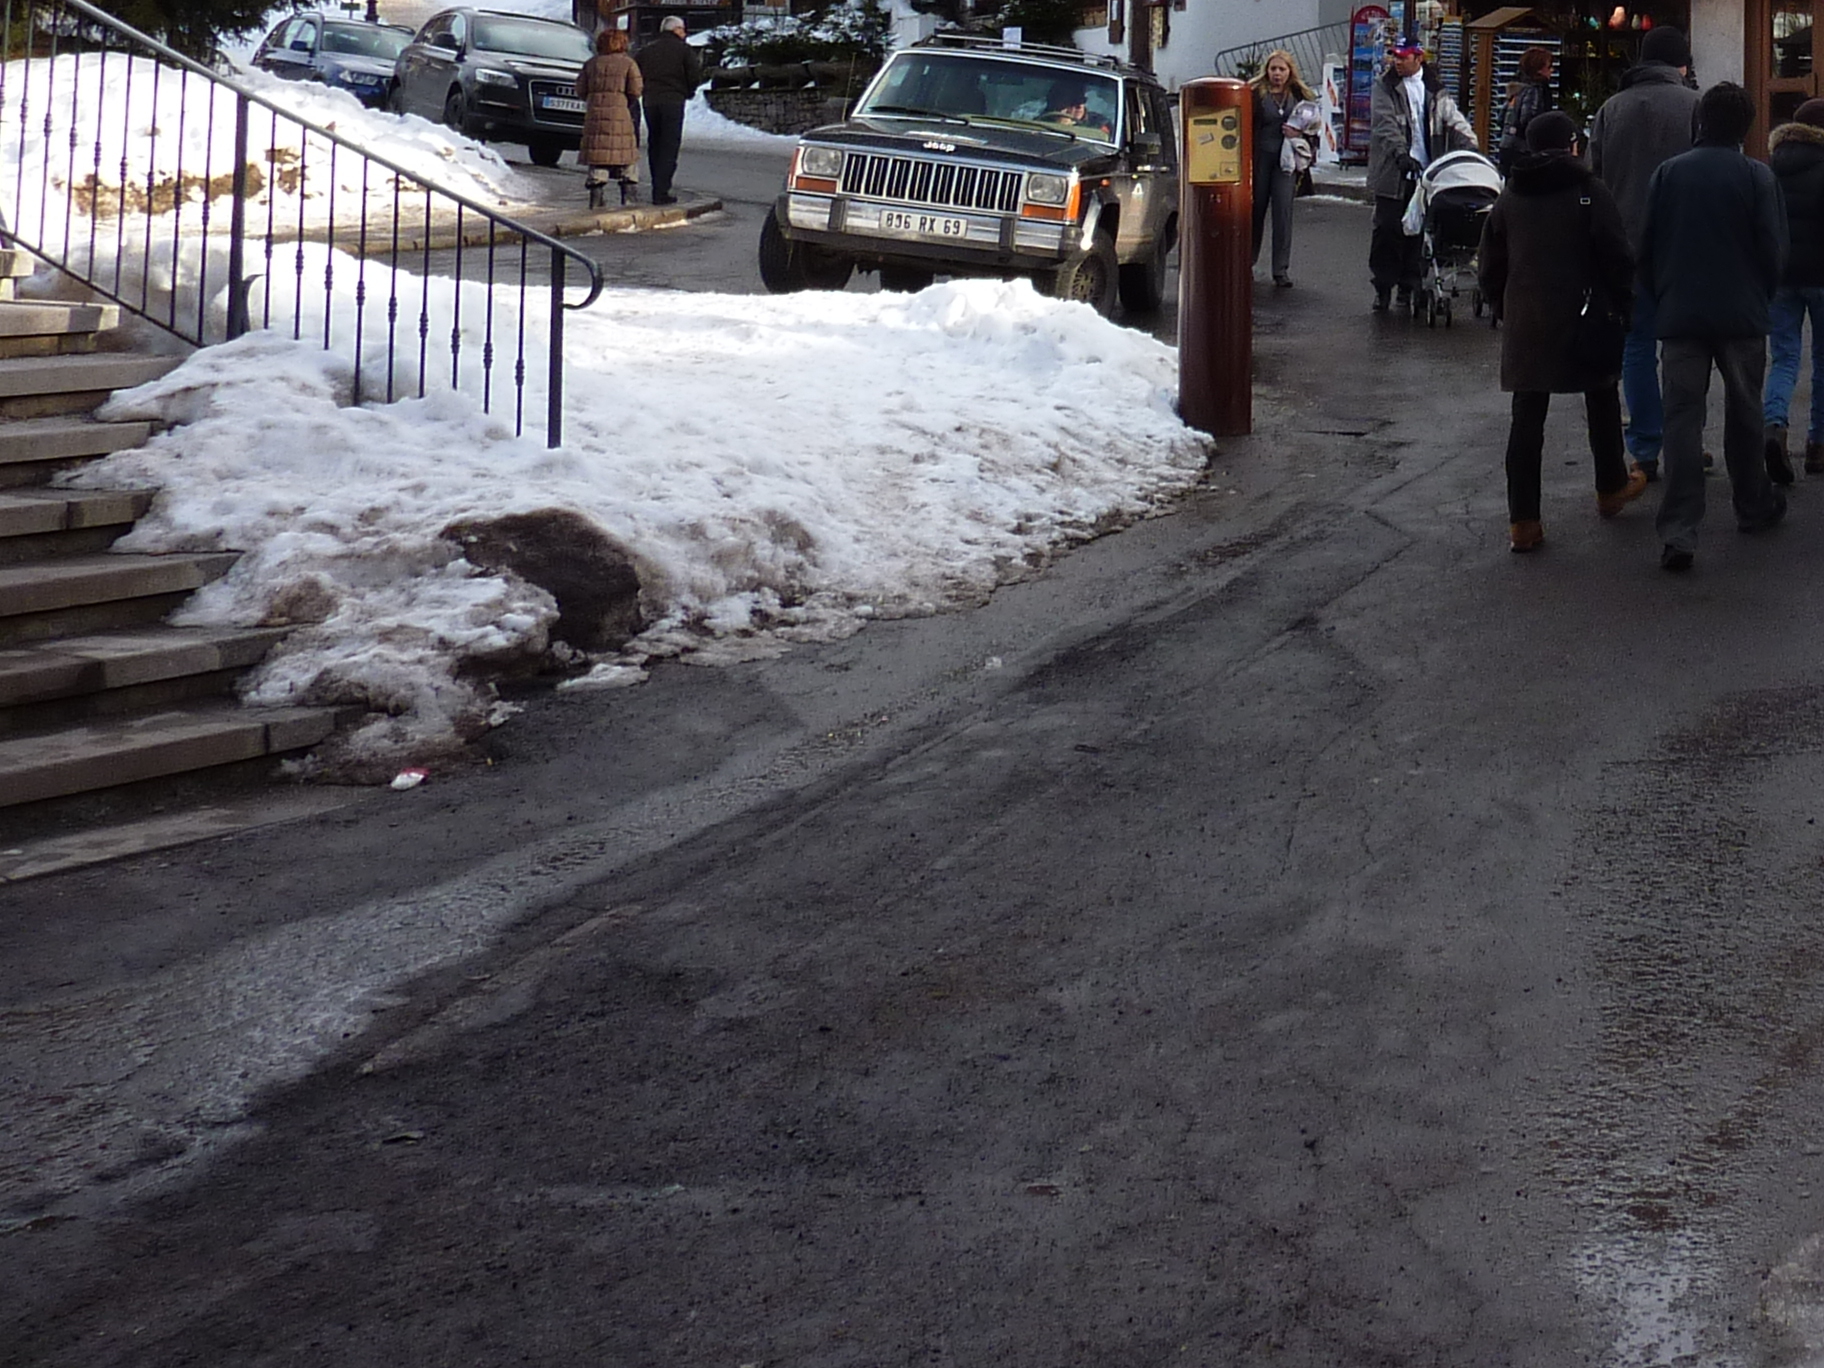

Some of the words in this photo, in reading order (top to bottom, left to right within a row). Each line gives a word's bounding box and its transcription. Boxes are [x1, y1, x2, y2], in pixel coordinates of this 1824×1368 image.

[922, 140, 956, 153] Jeep
[919, 216, 936, 233] RX
[943, 218, 961, 235] 69
